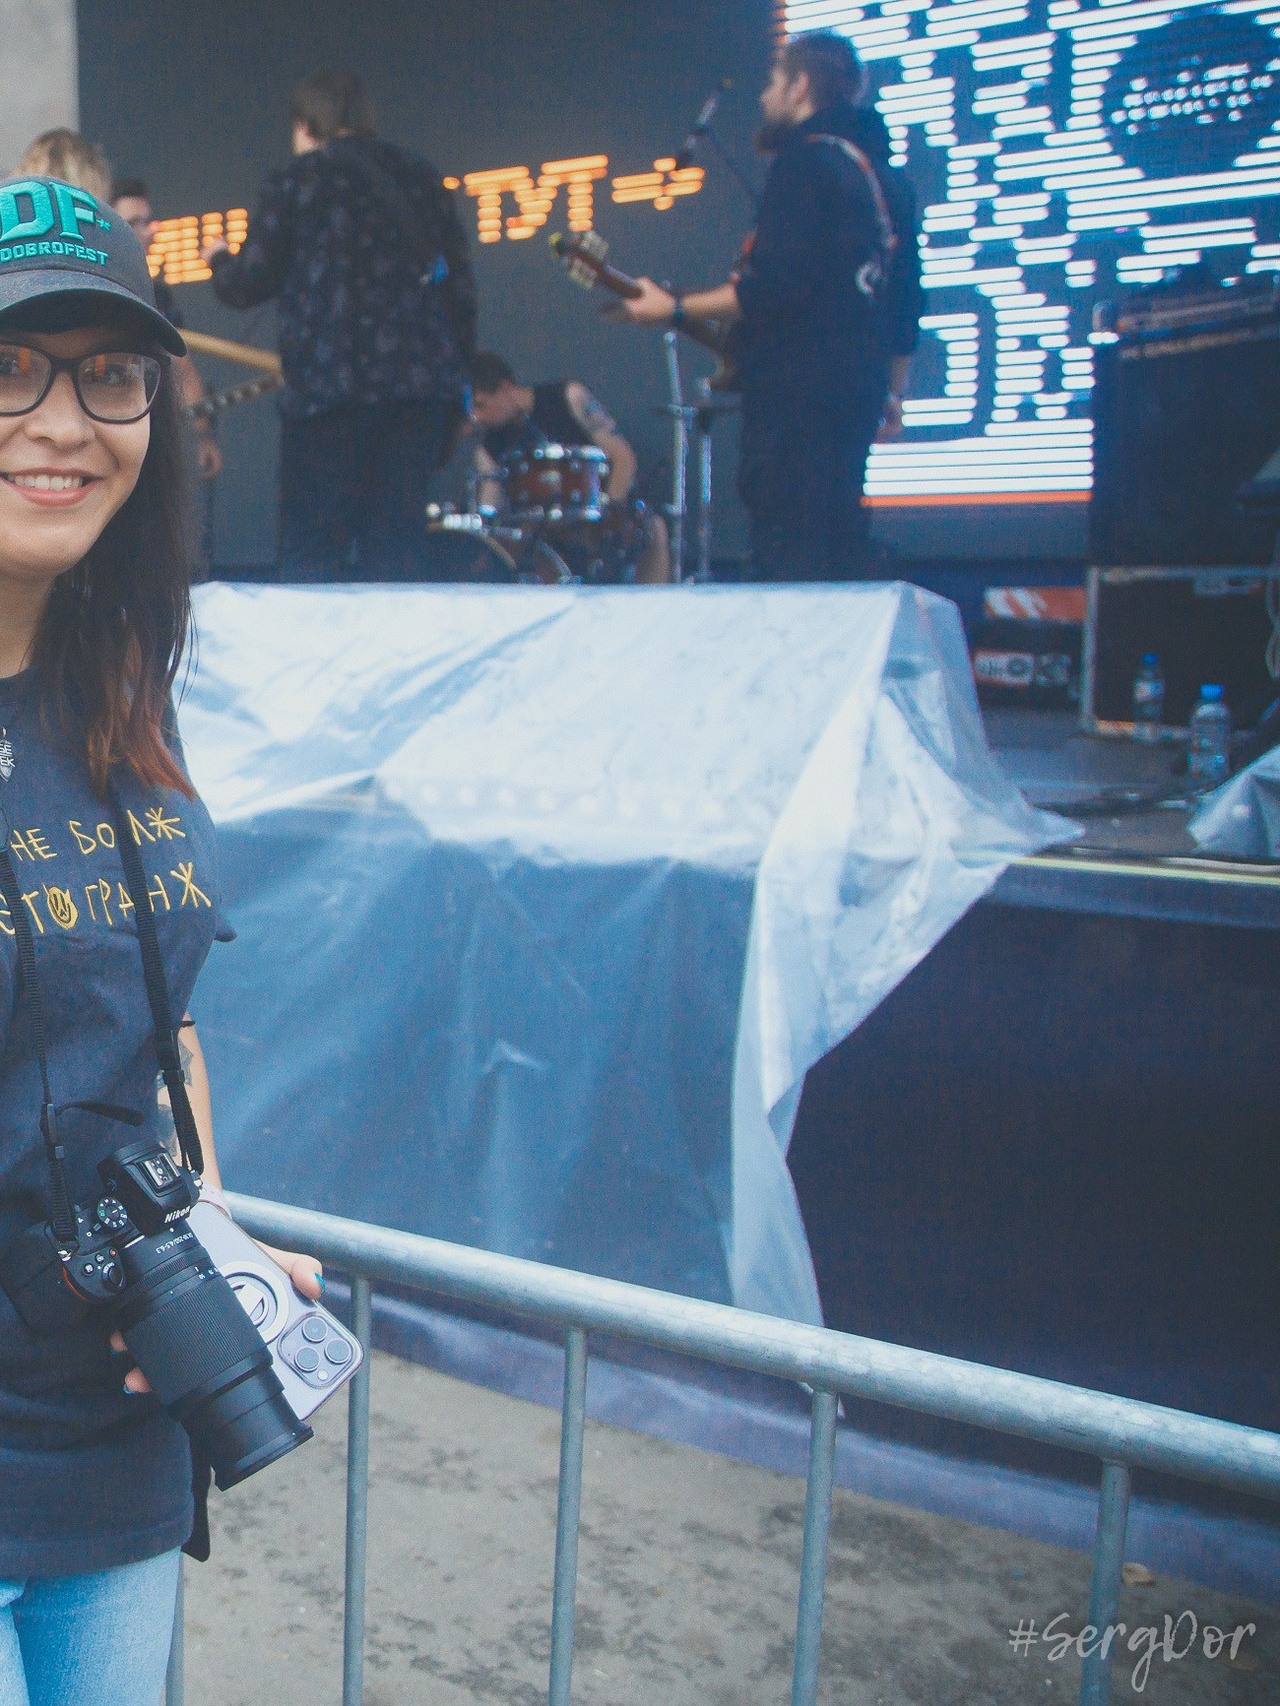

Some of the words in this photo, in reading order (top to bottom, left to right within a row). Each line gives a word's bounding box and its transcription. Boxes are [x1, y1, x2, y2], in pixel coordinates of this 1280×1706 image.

[10, 828, 58, 862] НЕ
[84, 861, 212, 926] ГРАНЖ
[164, 1205, 191, 1223] Nikon
